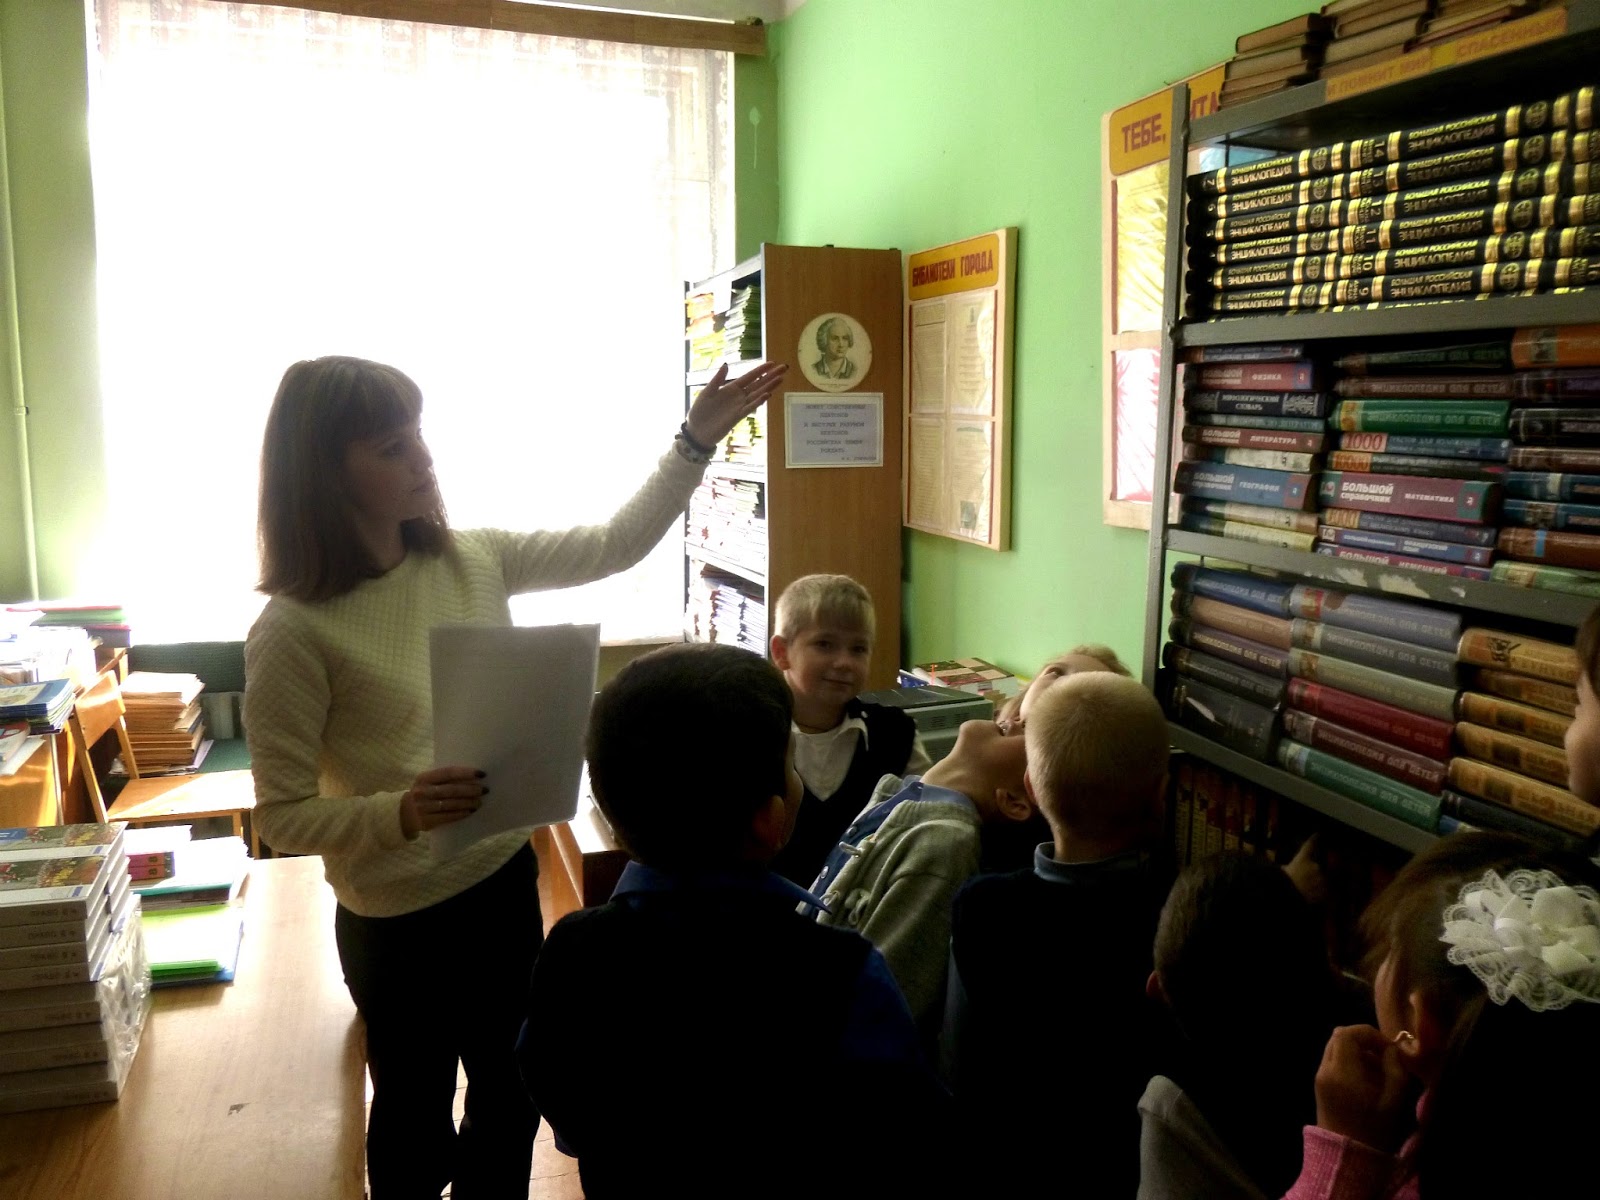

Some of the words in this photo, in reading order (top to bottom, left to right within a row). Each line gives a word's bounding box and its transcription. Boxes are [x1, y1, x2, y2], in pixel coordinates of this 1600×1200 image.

[1121, 113, 1166, 153] ТЕБЕ,
[1231, 165, 1292, 186] ЭНЦИКЛОПЕДИЯ
[1231, 193, 1292, 212] ЭНЦИКЛОПЕДИЯ
[1370, 200, 1383, 216] 12
[1229, 220, 1290, 238] ЭНЦИКЛОПЕДИЯ
[1366, 228, 1377, 244] 11
[1231, 244, 1291, 261] ЭНЦИКЛОПЕДИЯ
[961, 249, 993, 278] ГОРОДА
[1362, 254, 1374, 271] 10
[1227, 271, 1287, 287] ЭНЦИКЛОПЕДИЯ
[1359, 288, 1369, 296] 9
[1226, 297, 1283, 310] ЭНЦИКЛОПЕДИЯ
[1250, 435, 1297, 444] ЛИТЕРАТУРА
[1345, 434, 1383, 450] 1000
[1193, 472, 1235, 484] БОЛЬШОЙ
[1239, 481, 1280, 492] ГЕОГРАФИЯ
[1341, 482, 1394, 495] БОЛЬШОЙ
[1404, 493, 1454, 503] МАТЕМАТИКА
[1339, 551, 1390, 565] БОЛЬШОЙ
